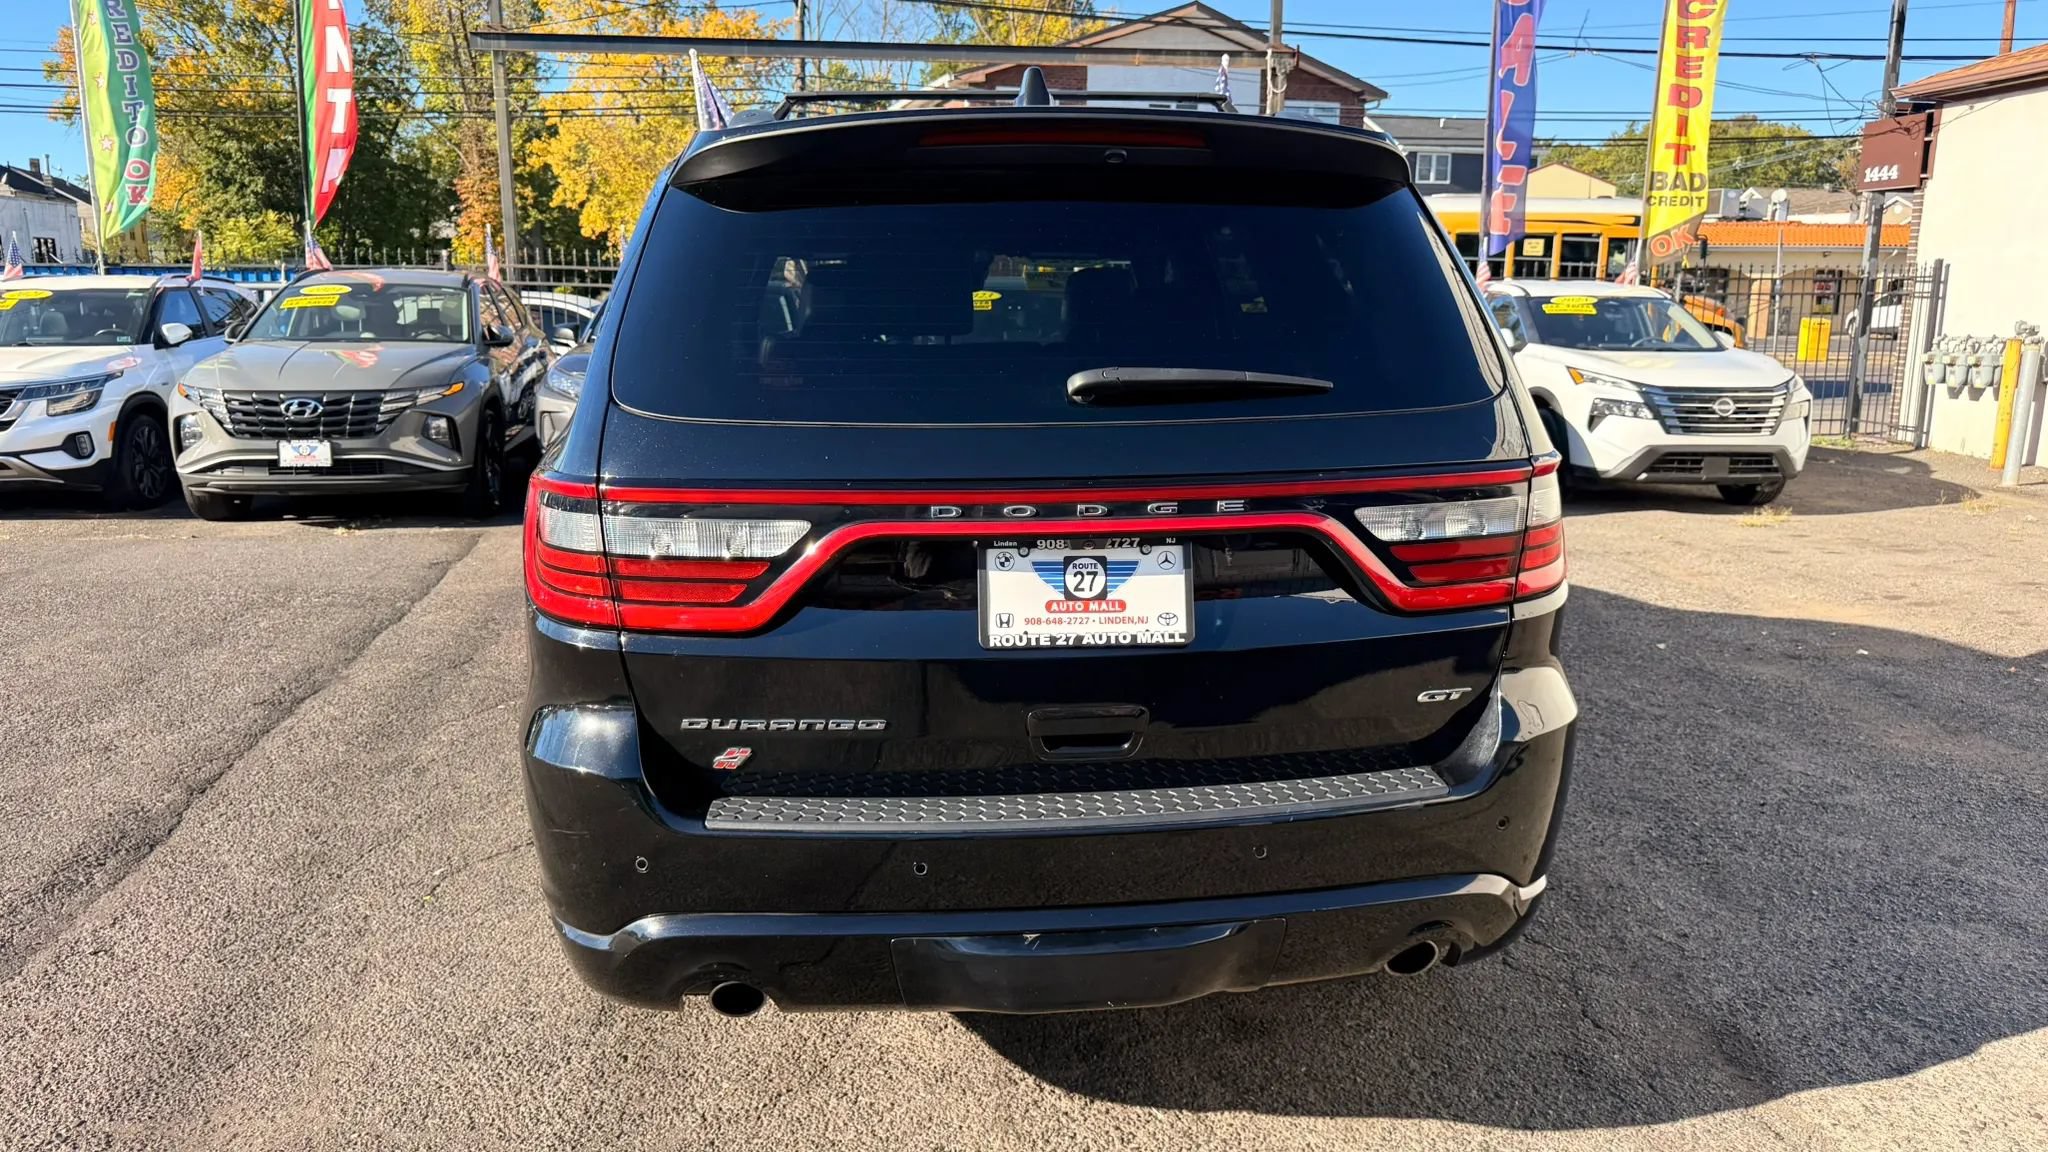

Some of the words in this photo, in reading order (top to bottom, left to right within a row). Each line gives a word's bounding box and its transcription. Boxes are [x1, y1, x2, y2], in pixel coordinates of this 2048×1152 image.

[1664, 0, 1718, 167] CREDIT
[320, 0, 352, 194] NTA
[1488, 0, 1535, 236] ALE
[1649, 171, 1708, 193] BAD
[1863, 164, 1899, 183] 1444
[1646, 195, 1706, 208] CREDIT
[1650, 222, 1696, 257] OK
[930, 500, 1246, 518] DODGE
[1072, 562, 1098, 570] ROUTE
[1073, 571, 1098, 593] 27
[1050, 601, 1084, 612] AUTO
[1089, 600, 1122, 611] MALL
[1024, 617, 1090, 625] 908-648-2727
[989, 633, 1051, 647] ROUTE
[1055, 632, 1078, 645] 27
[1083, 631, 1132, 645] AUTO
[1137, 630, 1185, 644] MALL
[1417, 688, 1472, 703] GT
[680, 718, 887, 731] DURANGO
